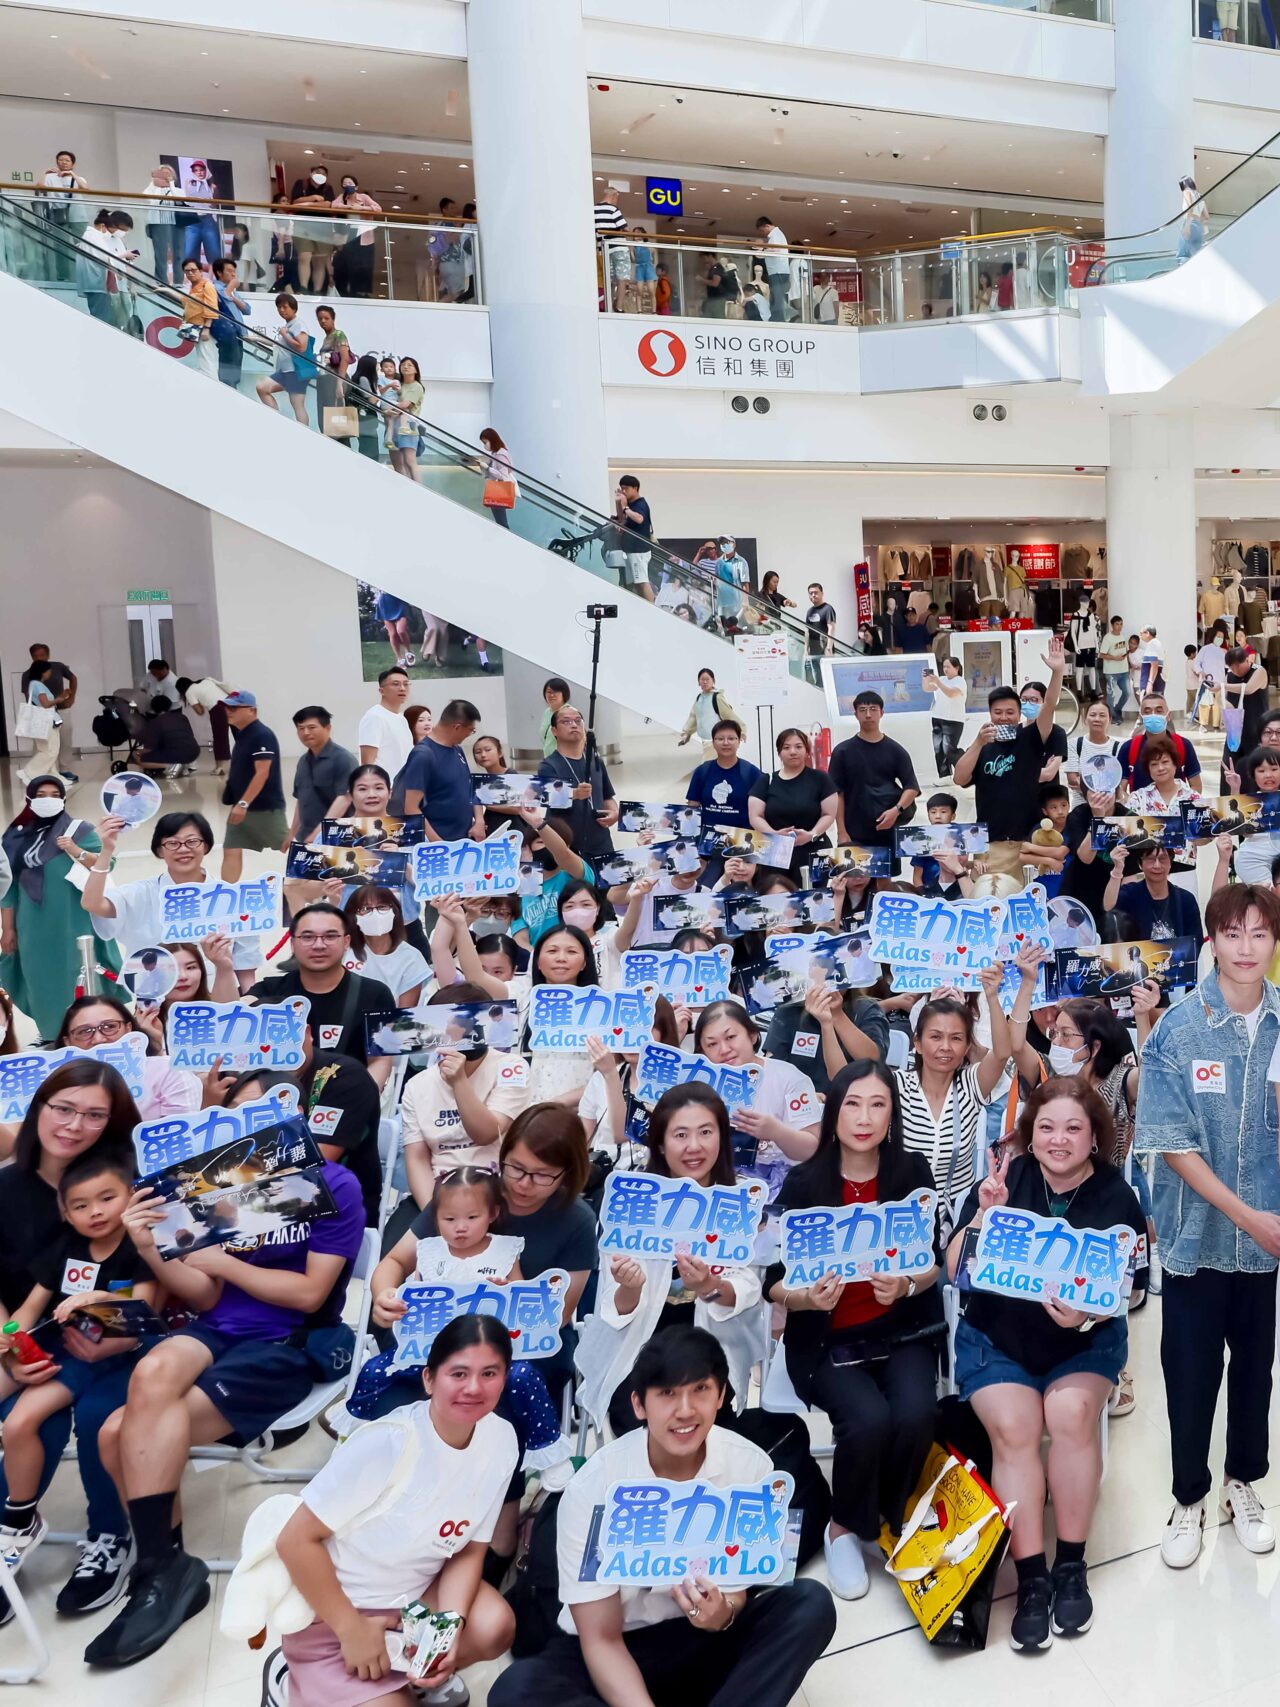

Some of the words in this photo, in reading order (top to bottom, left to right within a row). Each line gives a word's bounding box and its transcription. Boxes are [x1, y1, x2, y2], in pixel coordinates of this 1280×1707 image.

[11, 171, 33, 182] 出口
[650, 188, 681, 206] GU
[695, 336, 742, 351] SINO
[749, 338, 815, 354] GROUP
[696, 356, 794, 378] 信和集團
[1021, 558, 1056, 571] 感謝節
[127, 591, 149, 601] EXIT
[417, 838, 518, 880] 羅力威
[493, 875, 516, 890] Lo
[164, 878, 276, 922] 羅力威
[250, 914, 275, 932] Lo
[876, 895, 1001, 948] 羅力威
[345, 960, 364, 970] OC
[625, 950, 728, 988] 羅力威
[967, 952, 992, 968] Lo
[704, 988, 727, 1001] Lo
[533, 986, 652, 1028] 羅力威
[174, 1001, 303, 1047] 羅力威
[322, 1024, 340, 1040] OC
[623, 1031, 649, 1048] Lo
[796, 1034, 816, 1047] OC
[271, 1048, 299, 1066] Lo
[501, 1064, 524, 1078] OC
[1196, 1063, 1222, 1081] OC
[790, 1092, 810, 1112] OC
[312, 1108, 338, 1124] OC
[439, 1110, 460, 1119] BEW
[607, 1176, 759, 1238] 羅力威
[785, 1199, 933, 1261] 羅力威
[717, 1239, 749, 1260] Lo
[981, 1210, 1127, 1283] 羅力威
[898, 1250, 929, 1270] Lo
[67, 1265, 95, 1284] OC
[1083, 1284, 1115, 1308] Lo
[521, 1332, 556, 1353] Lo
[607, 1485, 784, 1548] 羅力威
[439, 1519, 471, 1538] OC
[738, 1553, 775, 1576] Lo
